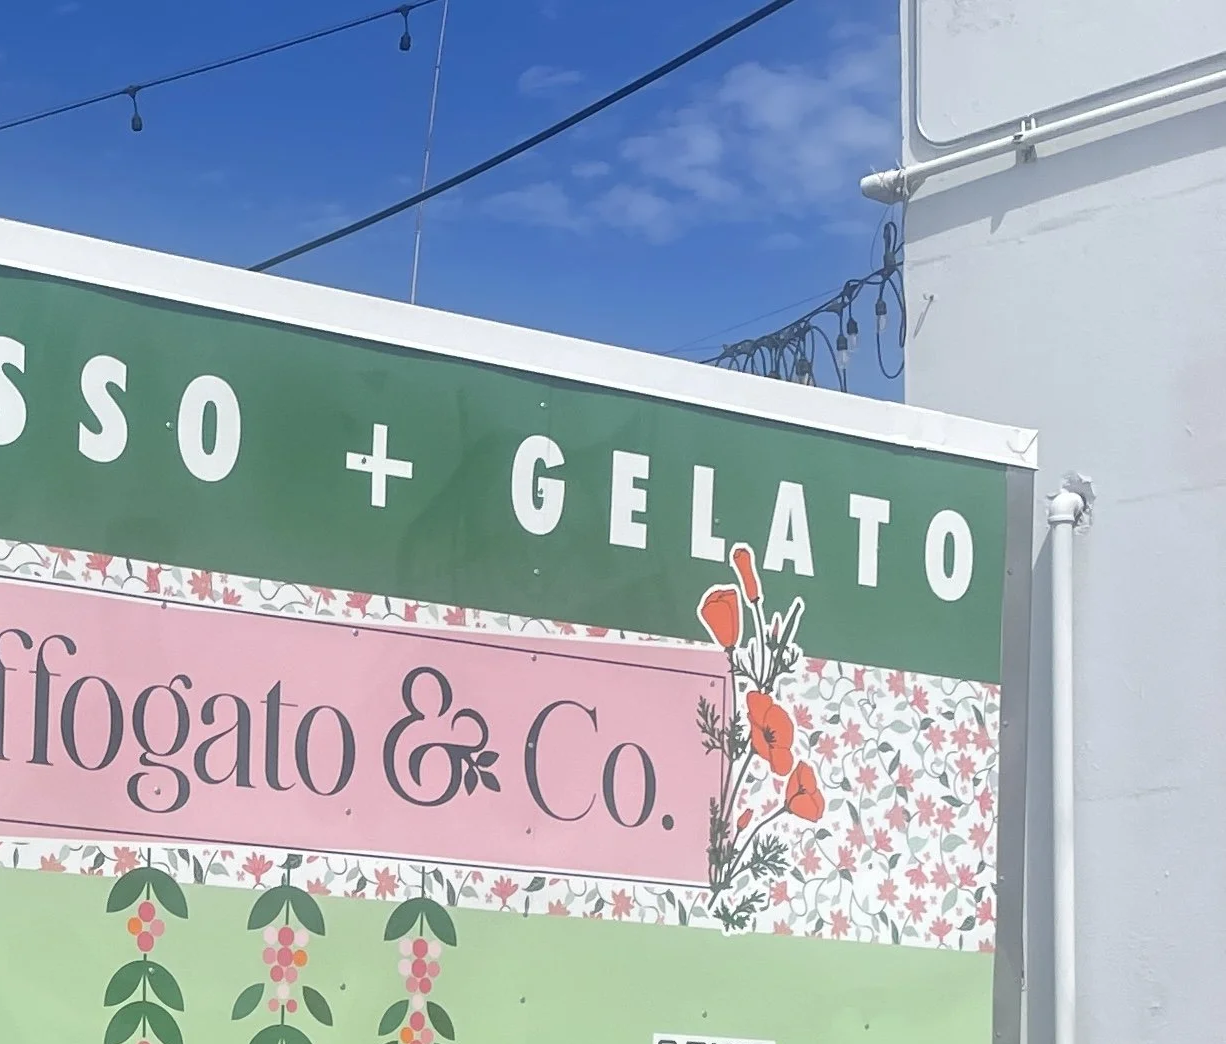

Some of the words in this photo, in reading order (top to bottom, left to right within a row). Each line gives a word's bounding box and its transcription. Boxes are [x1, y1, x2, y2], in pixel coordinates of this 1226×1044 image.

[345, 422, 414, 509] +
[510, 434, 974, 602] GELATO
[382, 665, 502, 808] &
[523, 699, 675, 832] Co.
